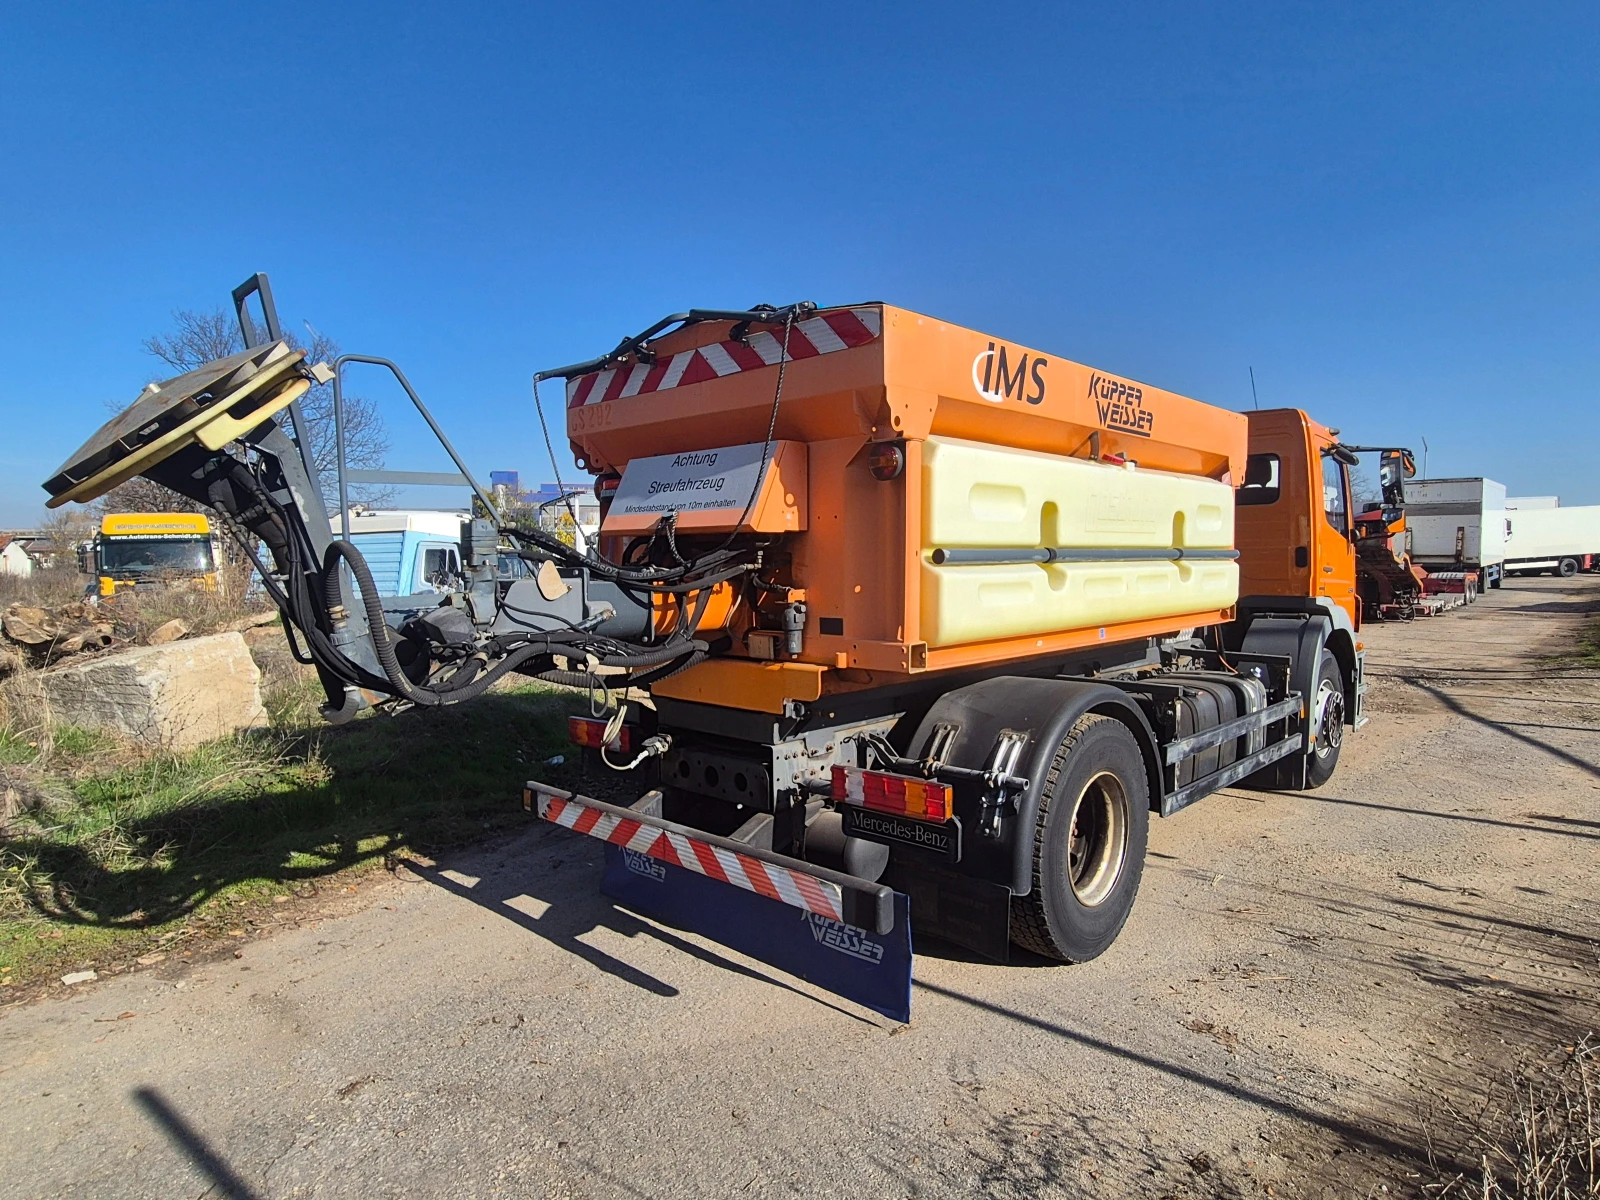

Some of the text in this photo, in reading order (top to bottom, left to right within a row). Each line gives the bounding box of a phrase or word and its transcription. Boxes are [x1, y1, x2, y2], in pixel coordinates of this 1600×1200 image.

[1087, 371, 1143, 408] KÜPPER
[1096, 400, 1154, 431] WEISSER
[671, 453, 718, 468] Achtung
[648, 477, 725, 494] Streufahrzeug
[624, 499, 737, 513] Mindestabstand von 10m einhalten
[851, 811, 948, 849] Mercedes-Benz
[810, 922, 884, 960] WEISSER
